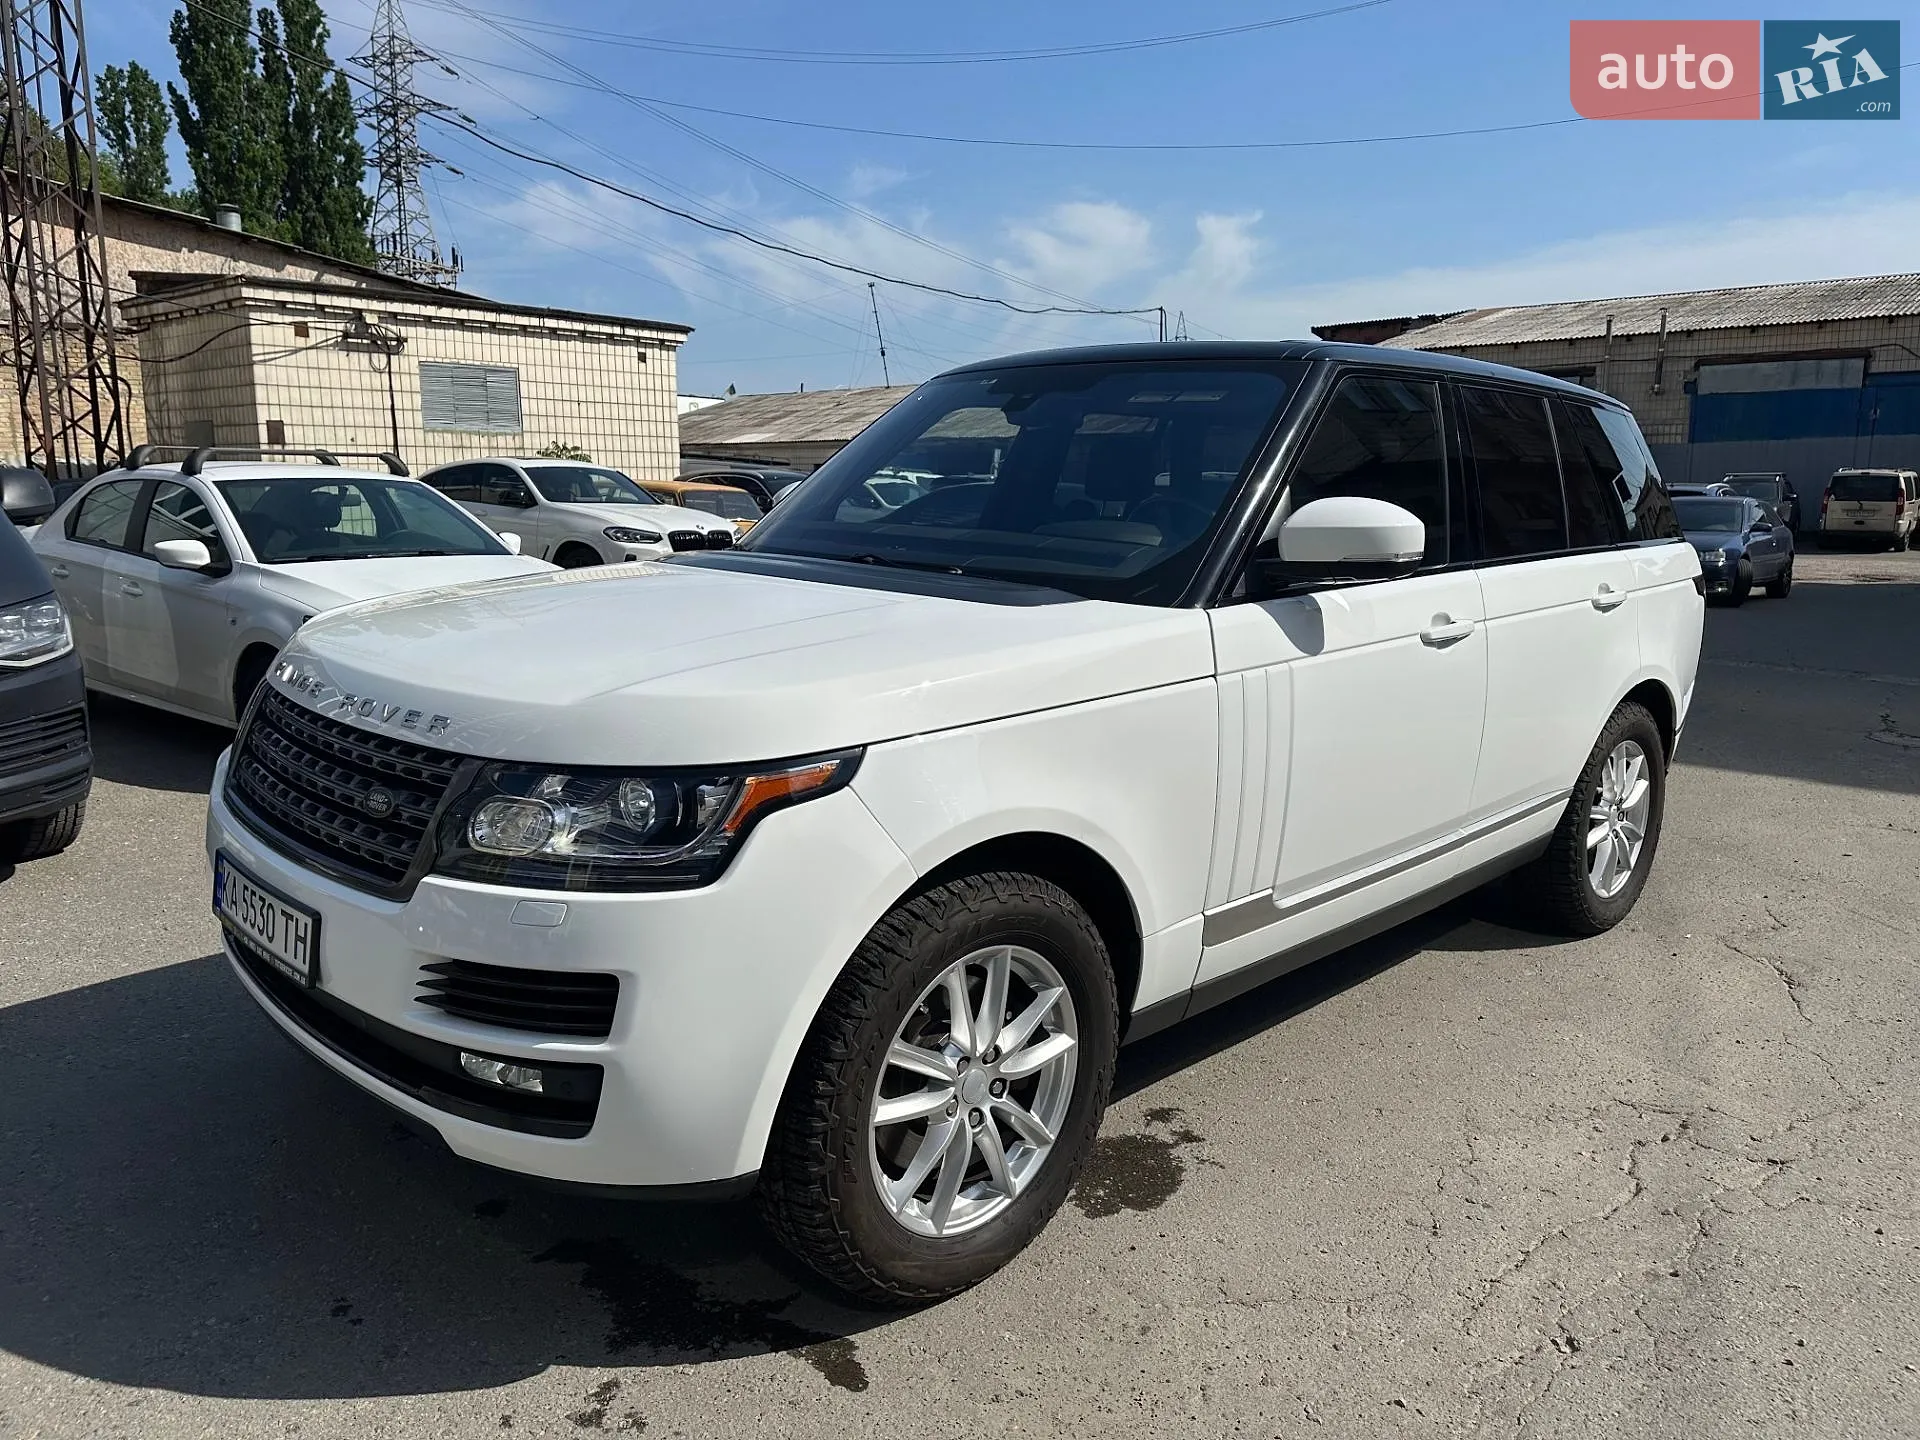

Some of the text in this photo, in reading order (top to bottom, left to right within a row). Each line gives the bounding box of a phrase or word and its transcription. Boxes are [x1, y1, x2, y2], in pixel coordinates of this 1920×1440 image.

[338, 693, 451, 737] ROVER
[222, 866, 238, 917] KA
[241, 883, 276, 944] 5530
[280, 908, 309, 966] TH
